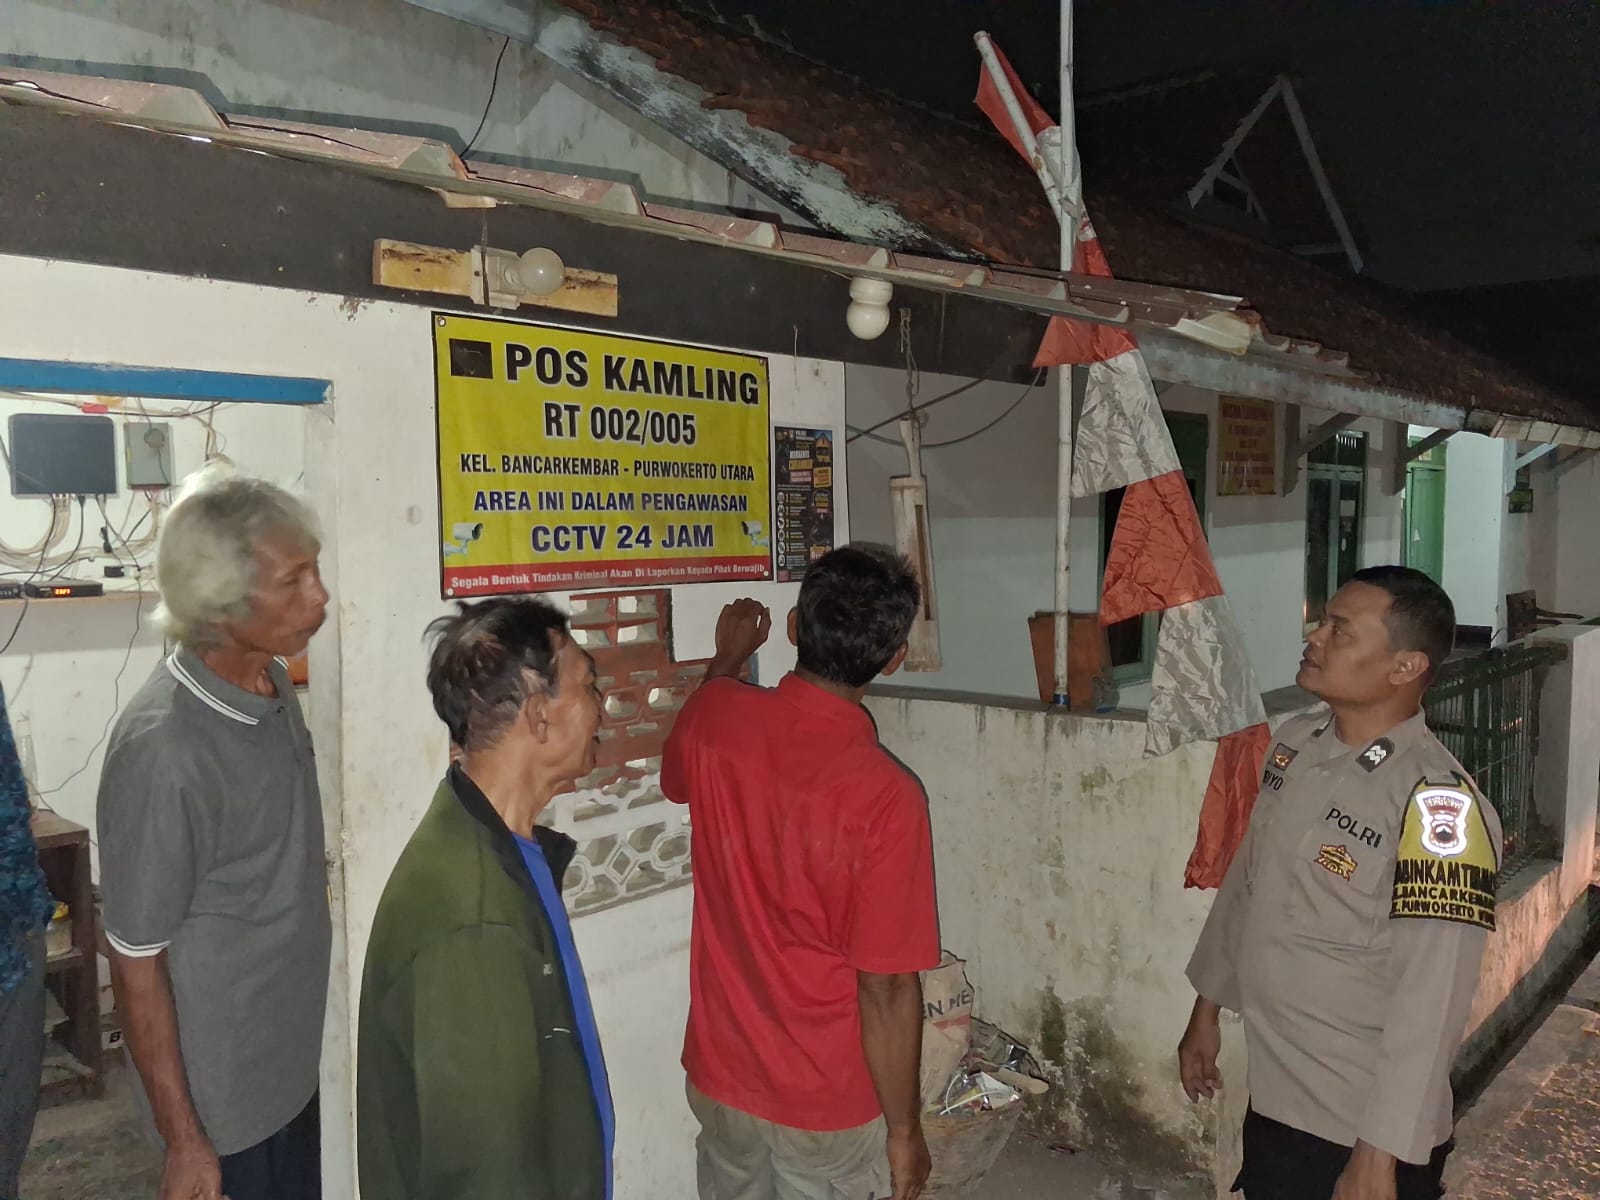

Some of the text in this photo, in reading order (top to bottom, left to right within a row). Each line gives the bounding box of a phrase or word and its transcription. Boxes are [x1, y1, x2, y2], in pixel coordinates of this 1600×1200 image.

[505, 343, 759, 404] POS KAMLING
[544, 402, 696, 445] RT 002/005
[461, 453, 496, 473] KEL.
[502, 455, 619, 476] BANCARKEMBAR
[634, 461, 717, 480] PURWOKERTO
[721, 464, 755, 481] UTARA
[474, 491, 748, 511] AREA INI DALAM PENGAWASAN
[531, 525, 714, 551] CCTV 24 JAM
[452, 576, 489, 589] Segala
[492, 574, 530, 585] Bentuk
[532, 571, 572, 583] Tindakan
[574, 569, 608, 580] Kriminal
[610, 568, 632, 578] Akan
[635, 568, 645, 577] Di
[648, 567, 685, 580] Laporkan
[732, 563, 765, 574] Berwajib
[1325, 807, 1382, 848] POLRI
